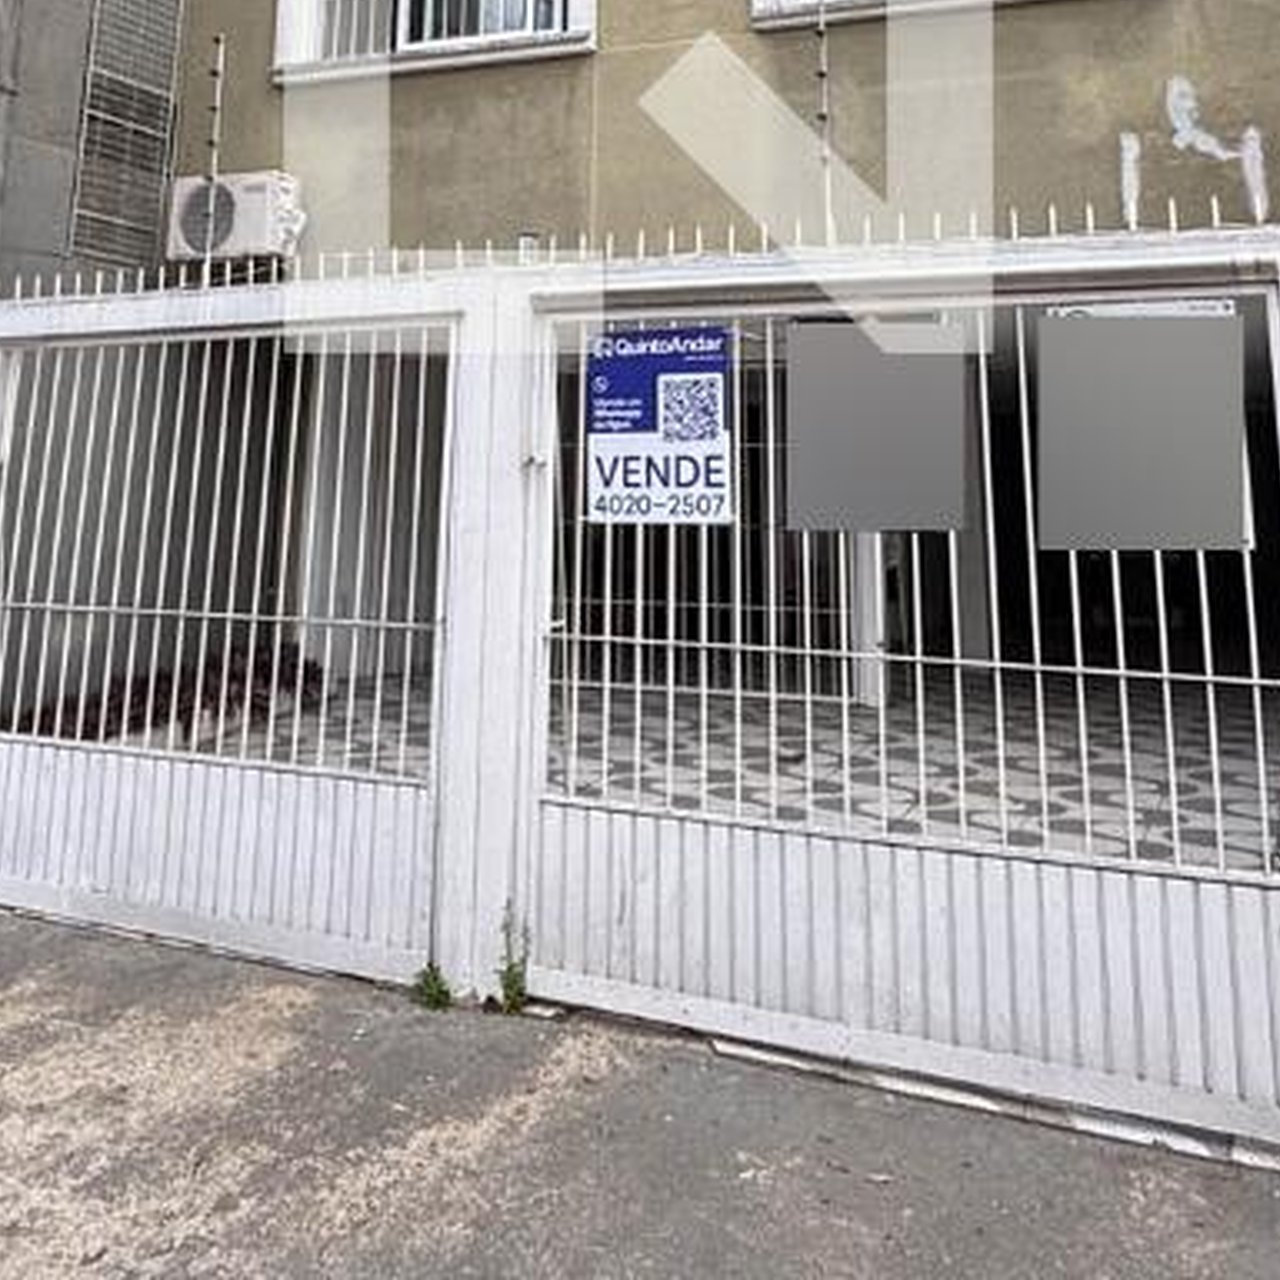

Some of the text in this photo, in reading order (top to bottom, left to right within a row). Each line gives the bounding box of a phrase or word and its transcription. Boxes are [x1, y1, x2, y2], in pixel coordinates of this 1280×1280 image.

[615, 336, 723, 356] QuintoAndar
[594, 455, 726, 489] VENDE
[593, 494, 726, 517] 4020-2507
